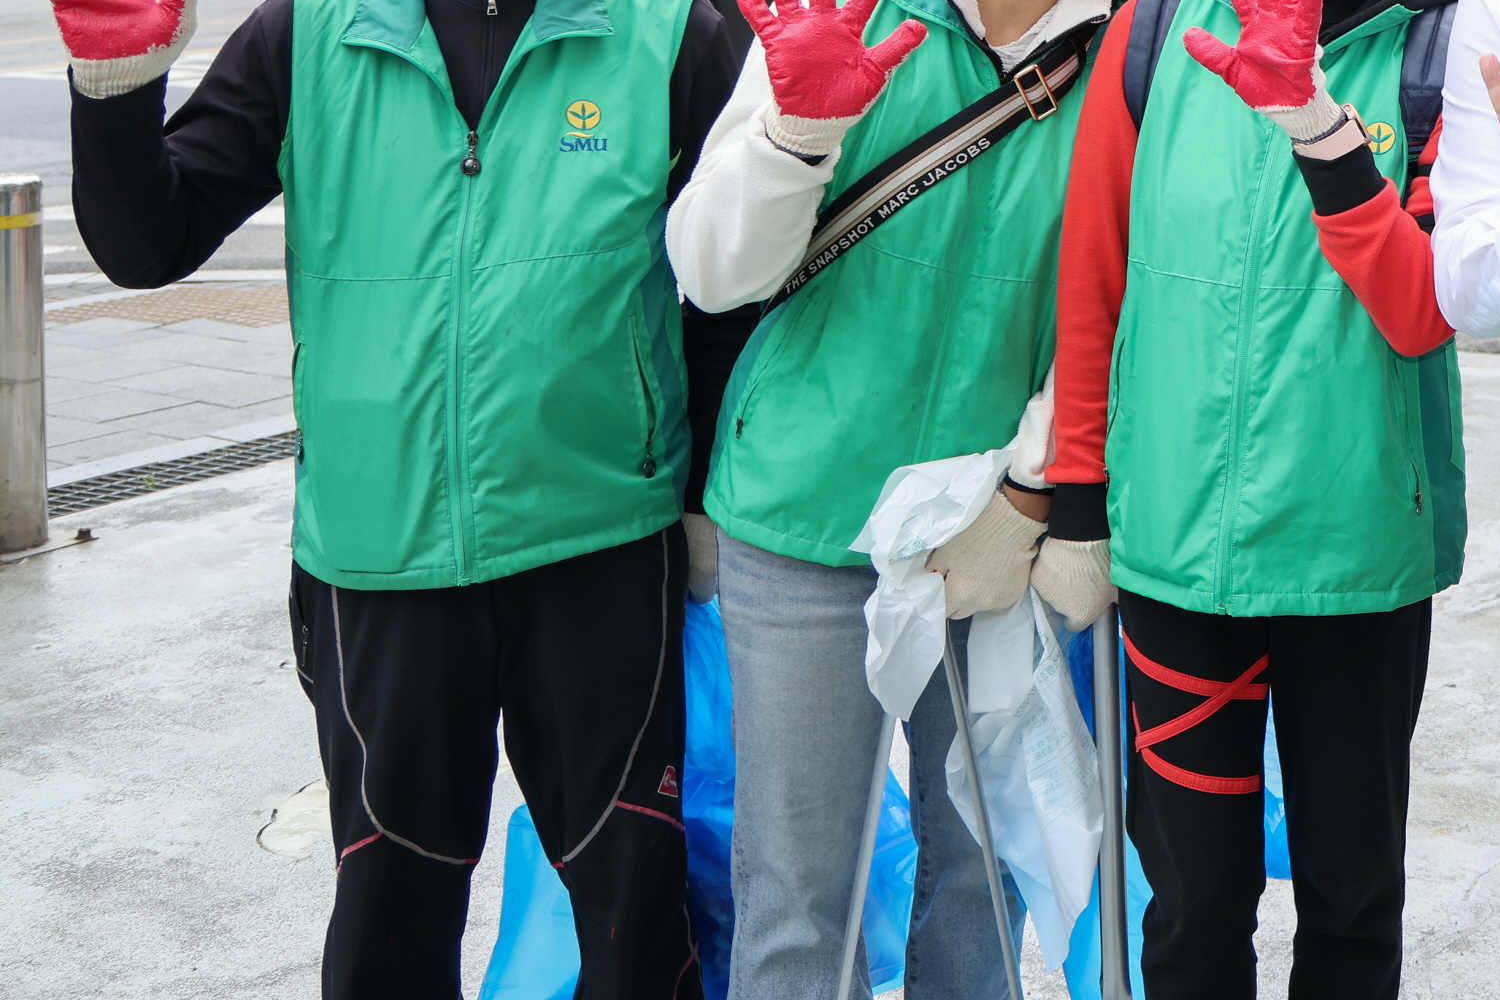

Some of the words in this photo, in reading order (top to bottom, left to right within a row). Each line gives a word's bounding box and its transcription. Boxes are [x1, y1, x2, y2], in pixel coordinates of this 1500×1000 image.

[559, 137, 608, 153] SMU
[784, 270, 806, 294] THE
[808, 216, 875, 273] SNAPSHOT
[878, 183, 919, 219] MARC
[922, 136, 991, 187] JACOBS
